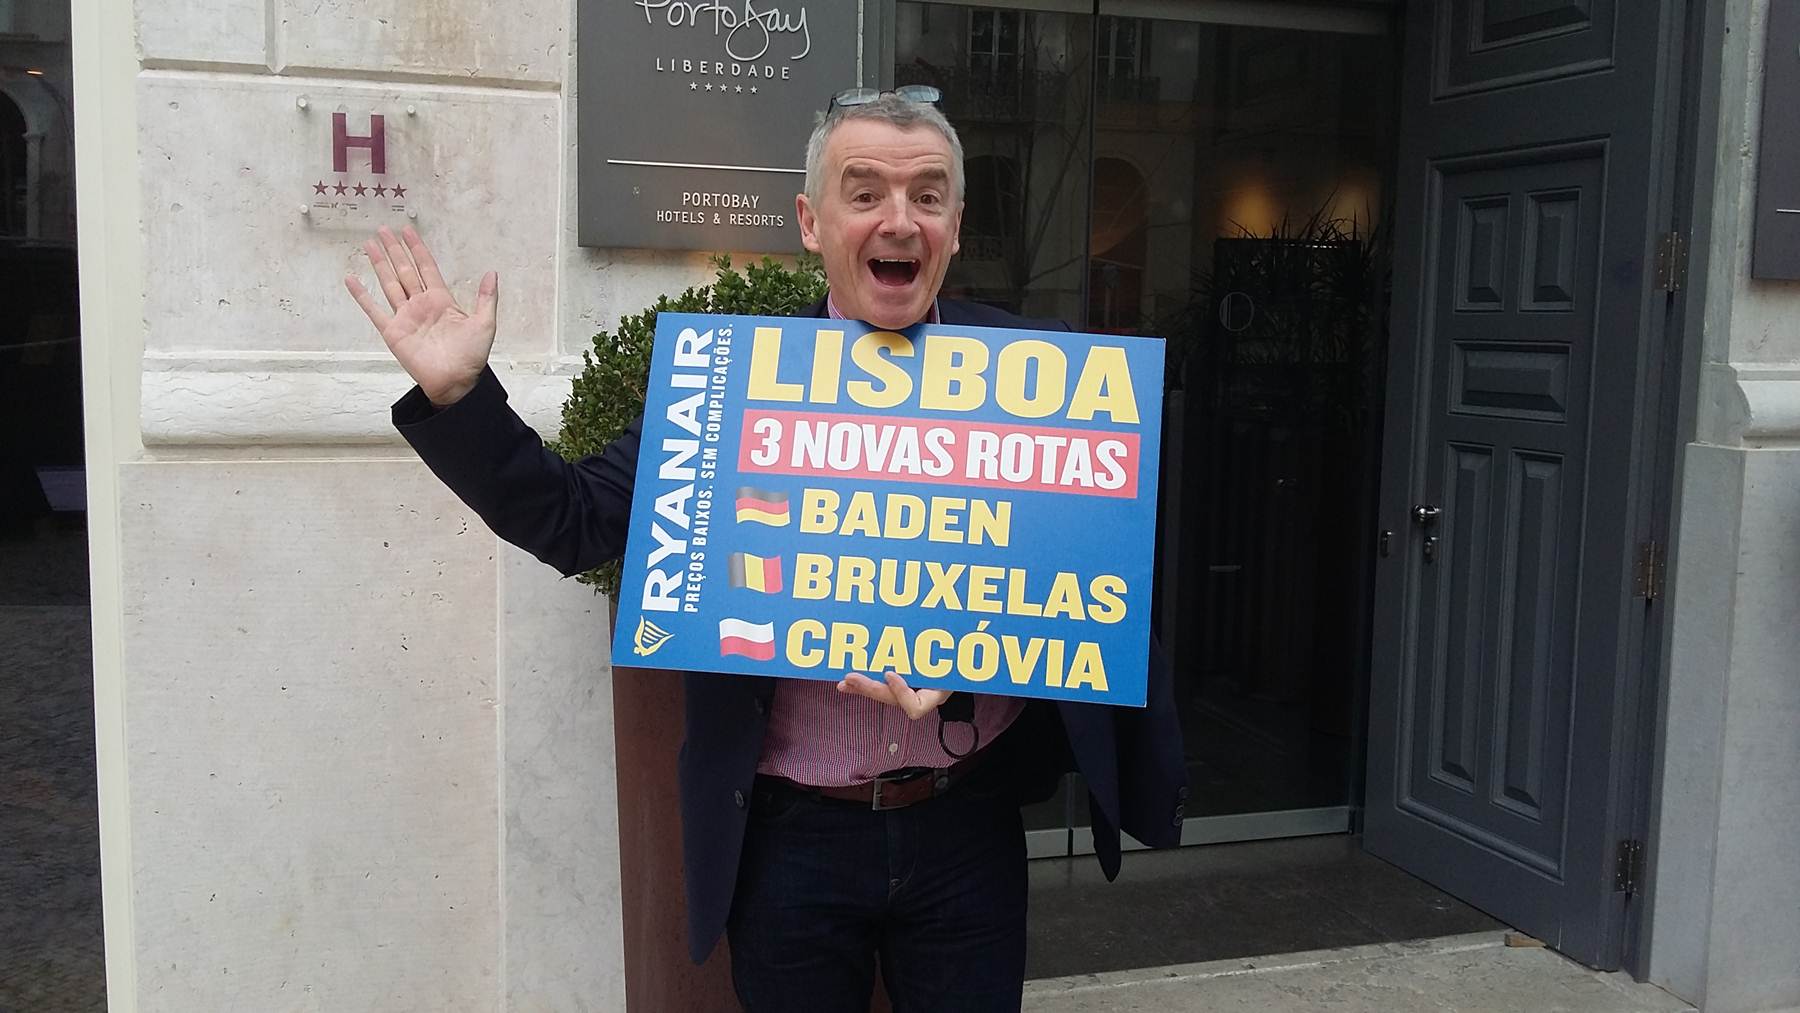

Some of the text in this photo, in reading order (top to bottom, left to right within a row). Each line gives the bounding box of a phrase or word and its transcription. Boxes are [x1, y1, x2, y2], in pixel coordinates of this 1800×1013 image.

[656, 57, 790, 80] LIBERDADE
[332, 112, 385, 174] H
[656, 210, 784, 227] HOTELS & RESORTS
[682, 192, 760, 208] PORTOBAY
[747, 327, 1140, 424] LISBOA
[641, 327, 715, 612] RYANAIR
[684, 323, 733, 613] PREÇOS BAIXOS. SEM COMPLICAÇÕES.
[750, 418, 1128, 490] 3 NOVAS ROTAS
[800, 488, 1012, 547] BADEN
[792, 553, 1128, 624] BRUXELAS
[786, 618, 1109, 692] CRACÓVIA
